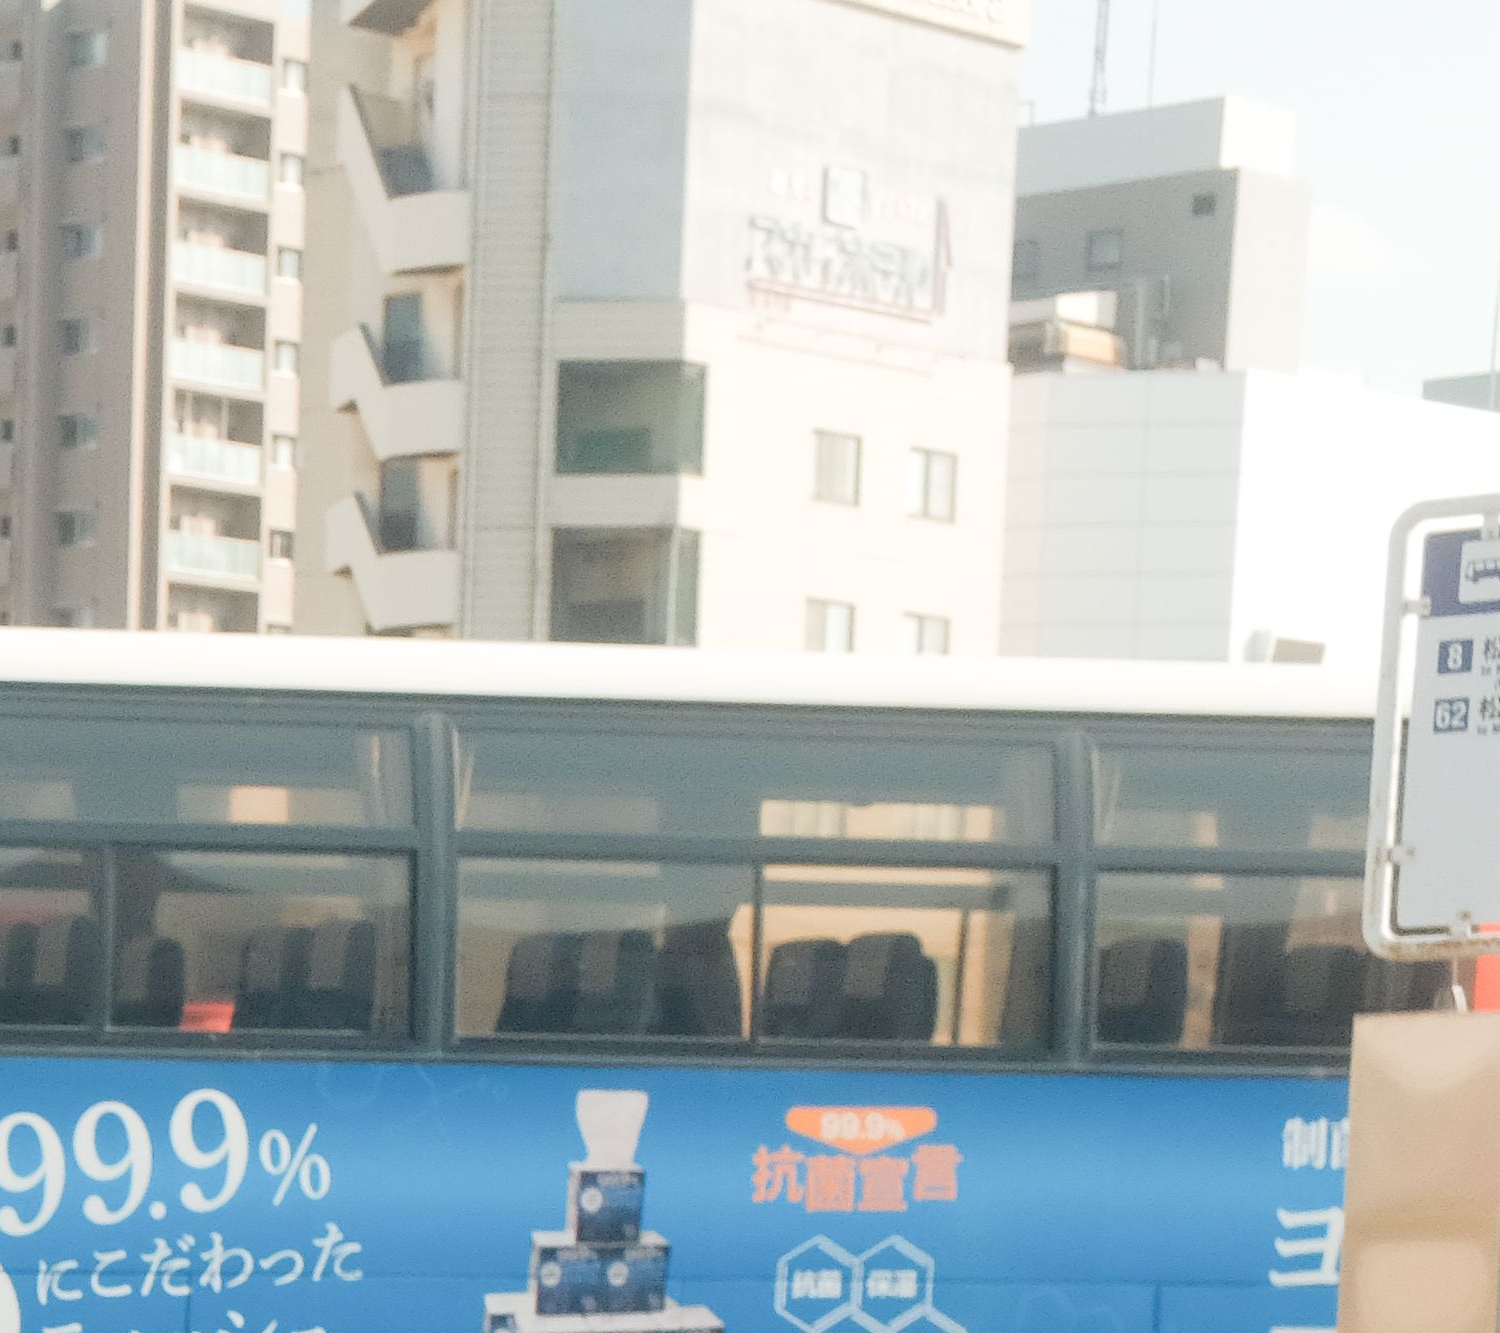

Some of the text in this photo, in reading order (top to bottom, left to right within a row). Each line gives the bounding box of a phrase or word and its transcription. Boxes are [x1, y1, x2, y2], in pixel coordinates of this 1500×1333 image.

[1446, 642, 1463, 670] 8
[1435, 700, 1467, 729] 62
[751, 1144, 964, 1213] 抗菌宣言
[36, 1222, 364, 1307] にこだわった
